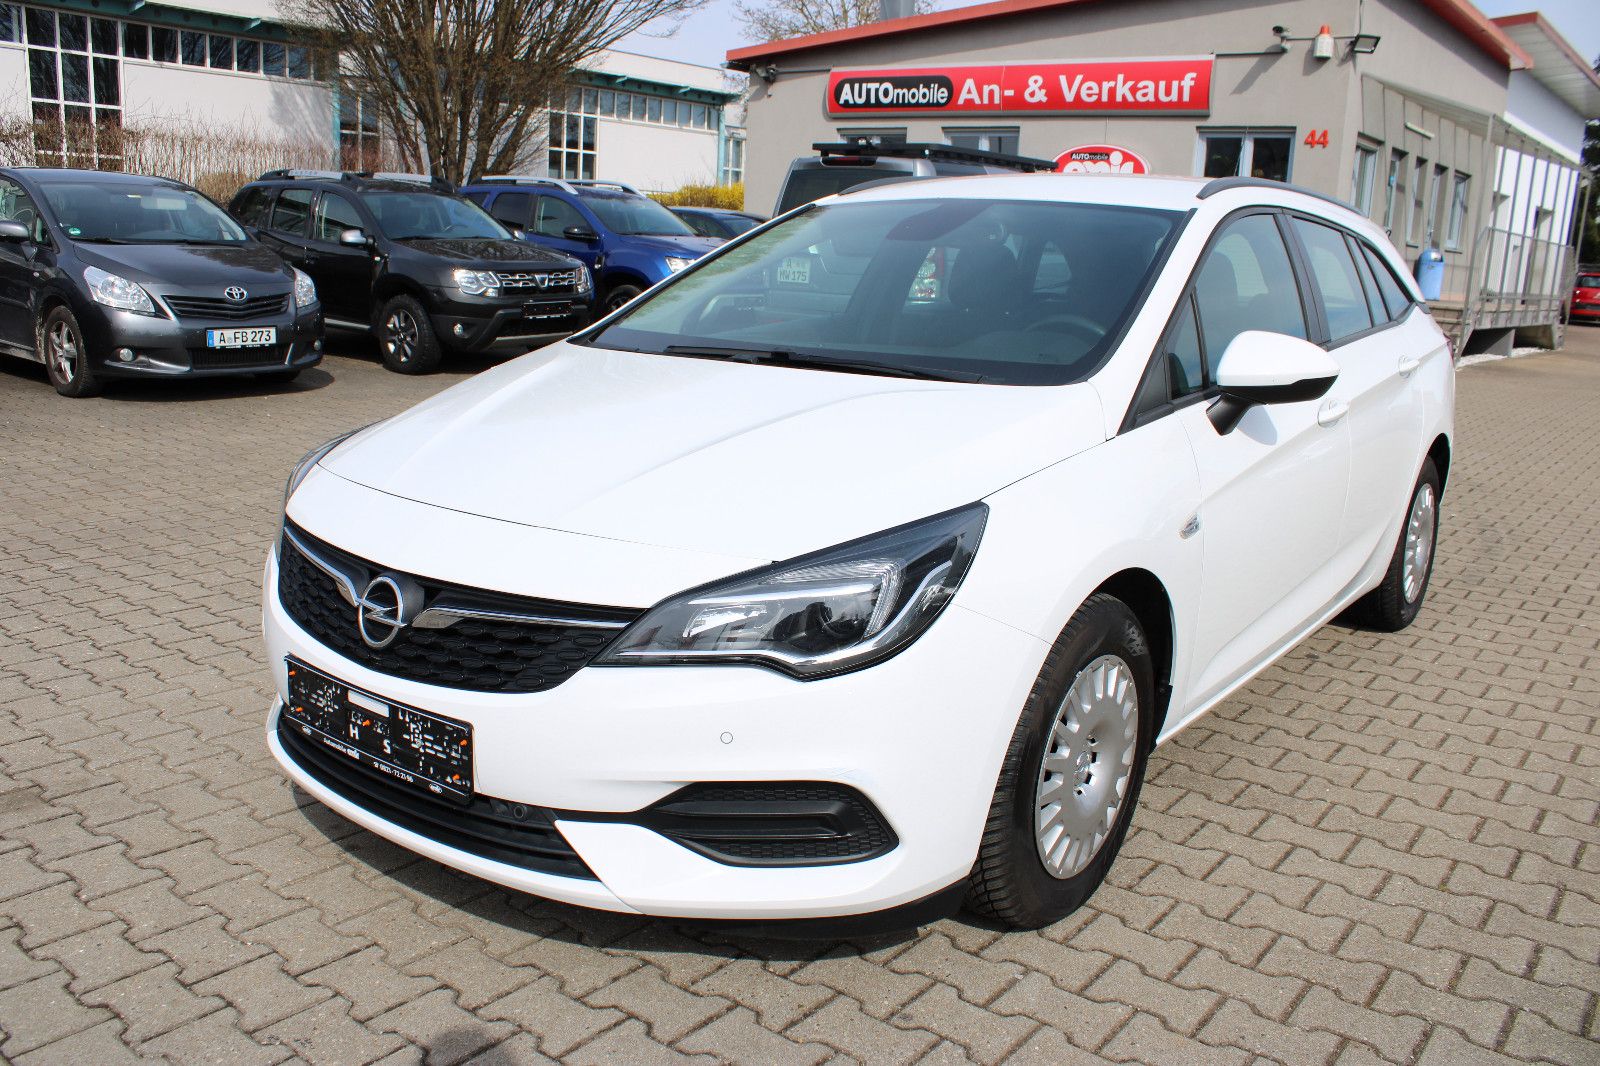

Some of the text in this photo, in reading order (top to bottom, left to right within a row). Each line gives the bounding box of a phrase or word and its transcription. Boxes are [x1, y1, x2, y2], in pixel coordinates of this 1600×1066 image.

[839, 72, 1197, 105] AUTOmobile An- & Verkauf
[1304, 129, 1329, 149] 44
[219, 330, 271, 344] A FB 273
